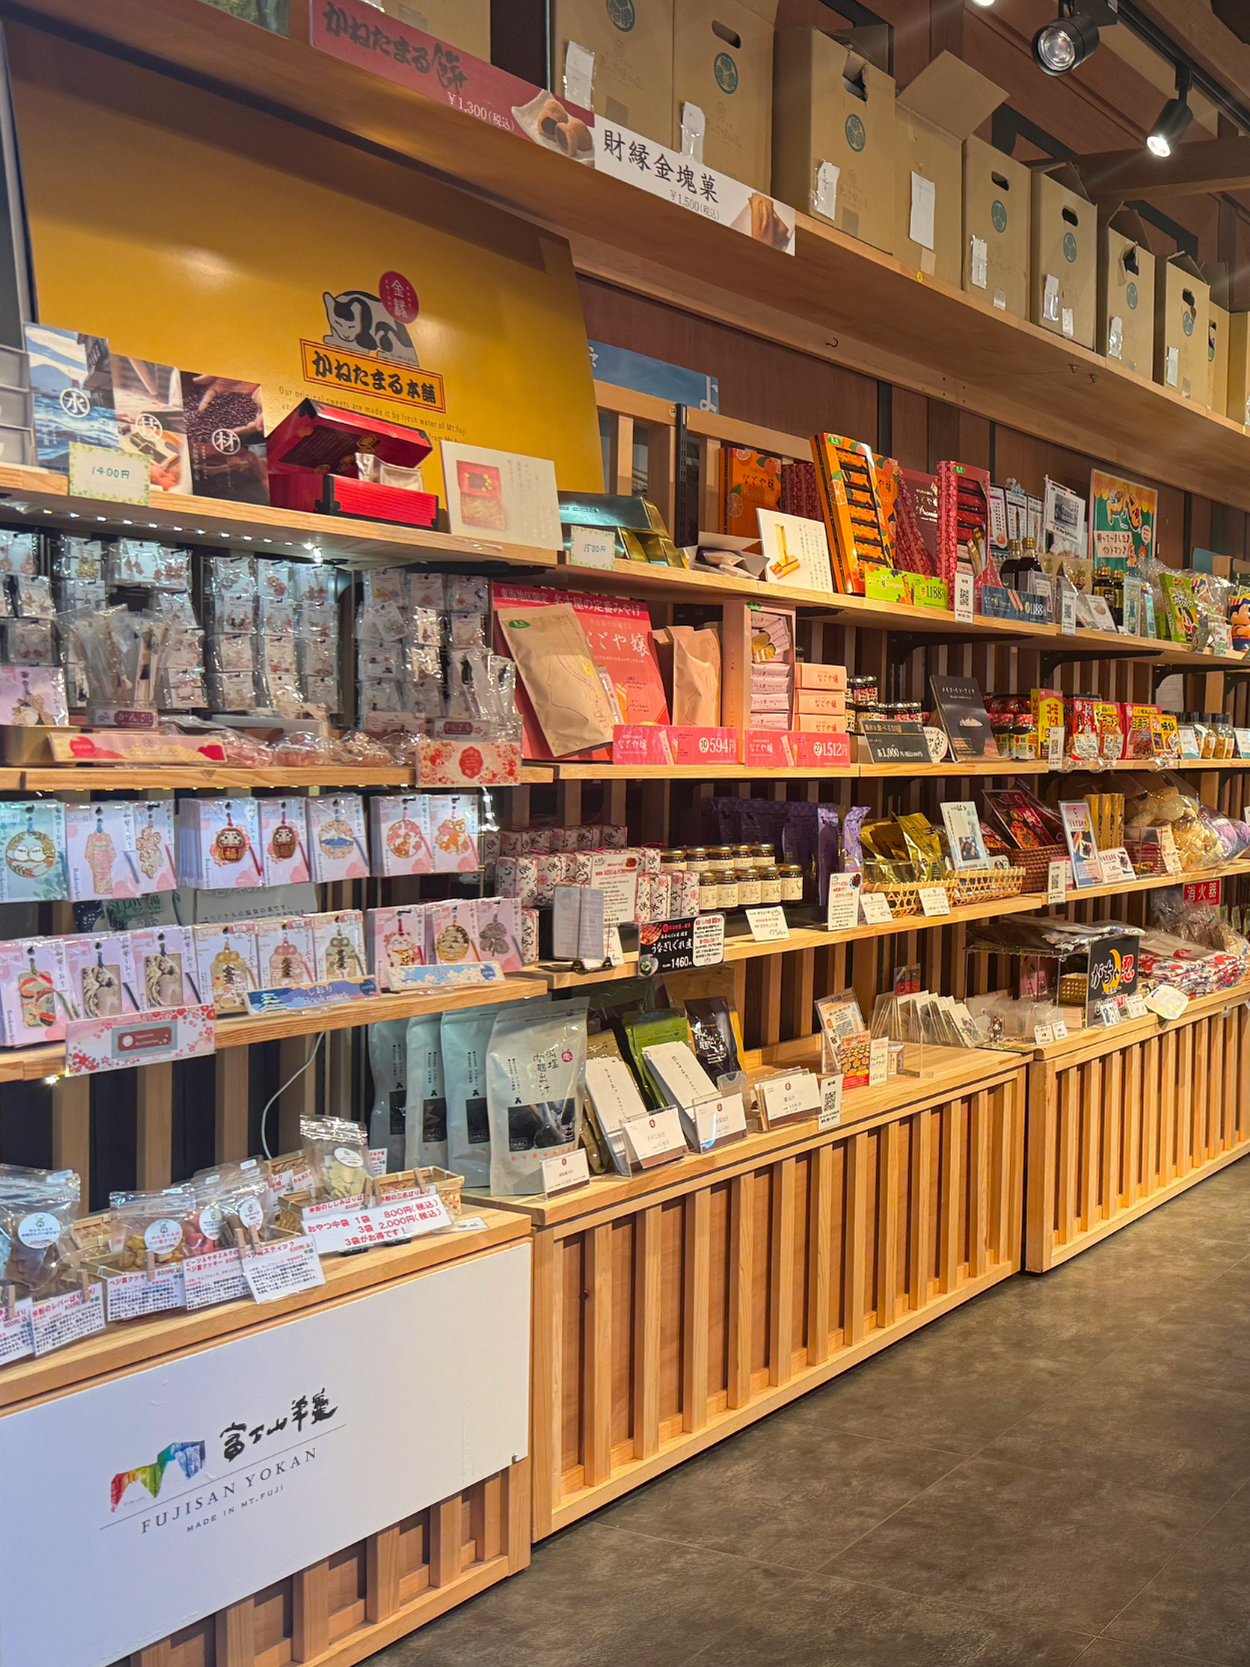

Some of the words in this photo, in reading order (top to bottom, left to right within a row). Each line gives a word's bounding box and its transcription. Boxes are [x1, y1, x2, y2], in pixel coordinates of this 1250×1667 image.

[322, 2, 468, 94] かねたまる餅
[67, 391, 86, 414] 水
[279, 386, 294, 397] Our
[352, 402, 364, 413] are
[365, 405, 384, 416] made
[392, 410, 401, 422] by
[401, 412, 418, 424] fresh
[419, 417, 437, 429] water
[438, 420, 446, 429] of
[215, 433, 236, 453] 材
[92, 465, 131, 480] 1400円
[1185, 882, 1218, 901] 消火器
[306, 1216, 350, 1234] おやつ中袋
[383, 1198, 439, 1220] 800円(税込)
[378, 1208, 442, 1231] 2,000円(税込)
[141, 1482, 237, 1535] FUJISAN
[245, 1446, 318, 1489] YOKAN
[187, 1514, 218, 1533] MADE
[223, 1505, 236, 1518] IN
[240, 1484, 285, 1509] MT.FUJI
